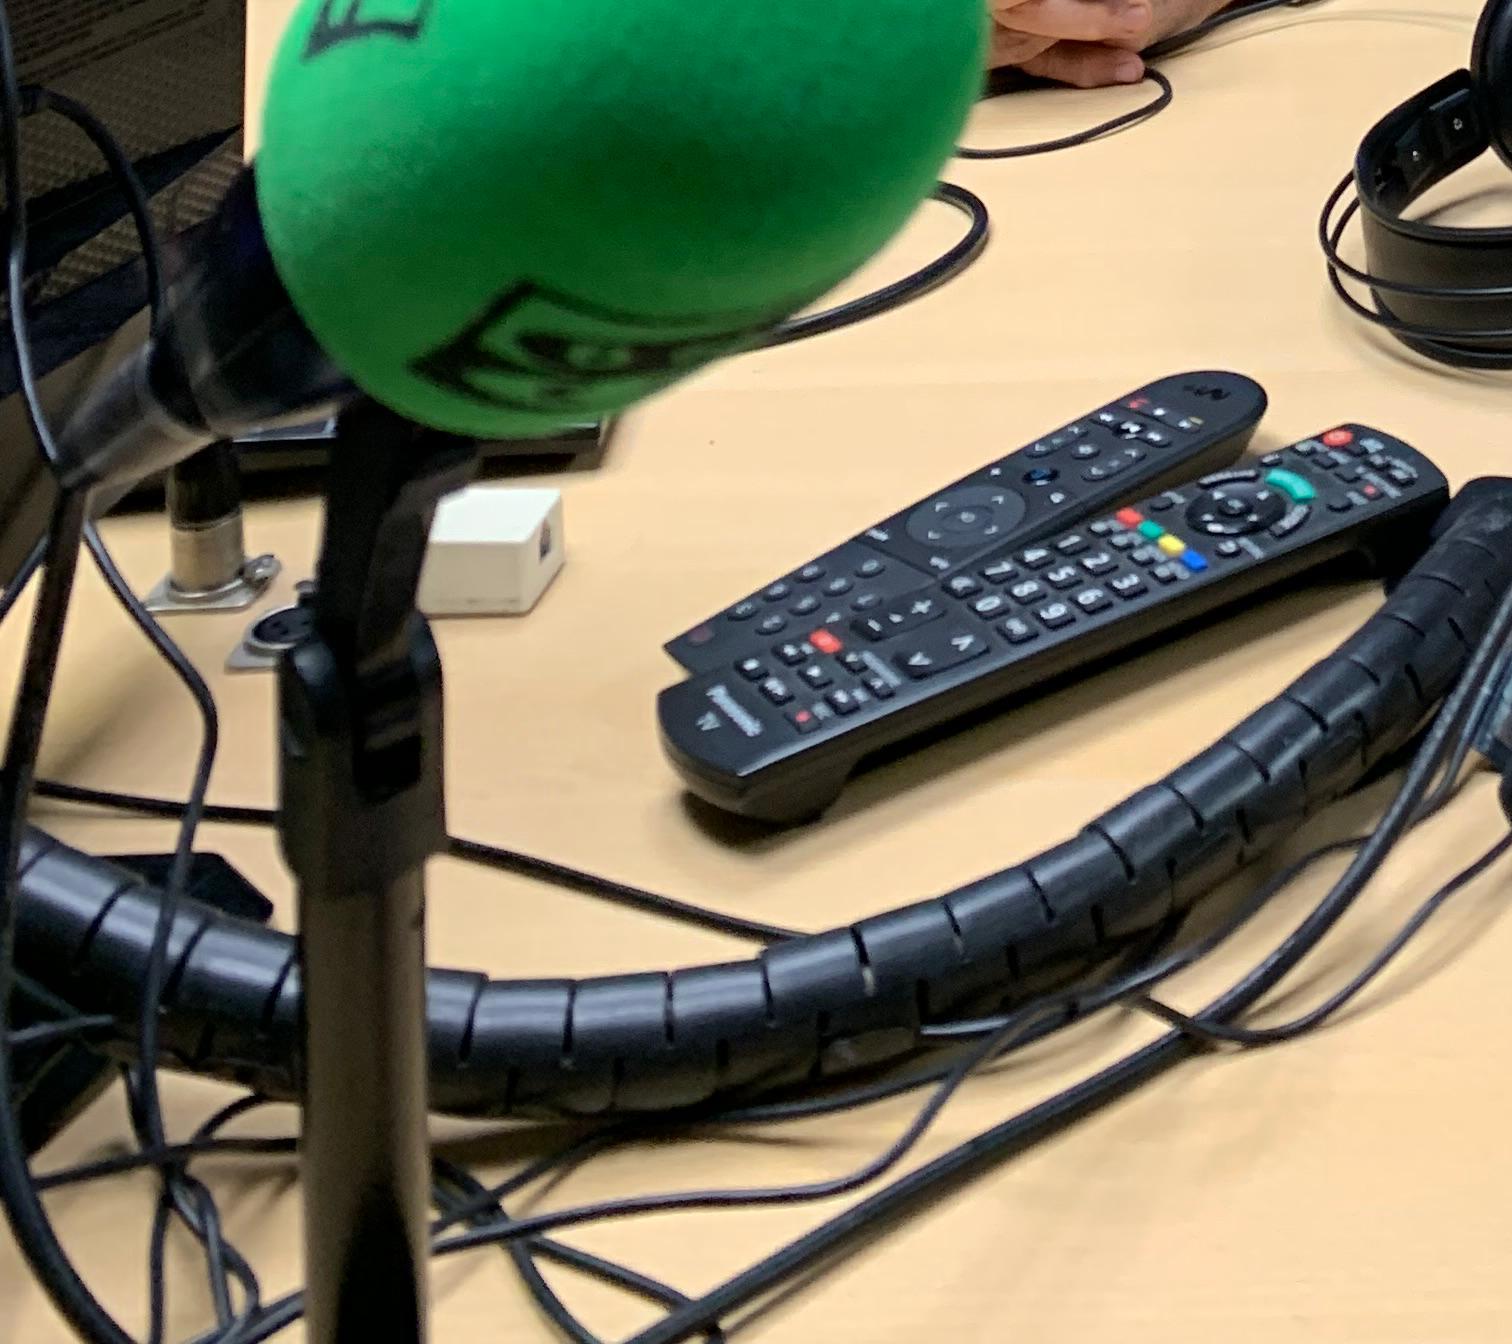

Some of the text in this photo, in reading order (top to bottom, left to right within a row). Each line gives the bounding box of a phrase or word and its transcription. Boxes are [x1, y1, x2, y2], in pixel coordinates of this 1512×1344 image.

[1012, 580, 1039, 597] 8
[1040, 603, 1067, 620] 9
[1048, 565, 1077, 582] 5
[1077, 589, 1104, 605] 6
[1112, 573, 1140, 590] 3
